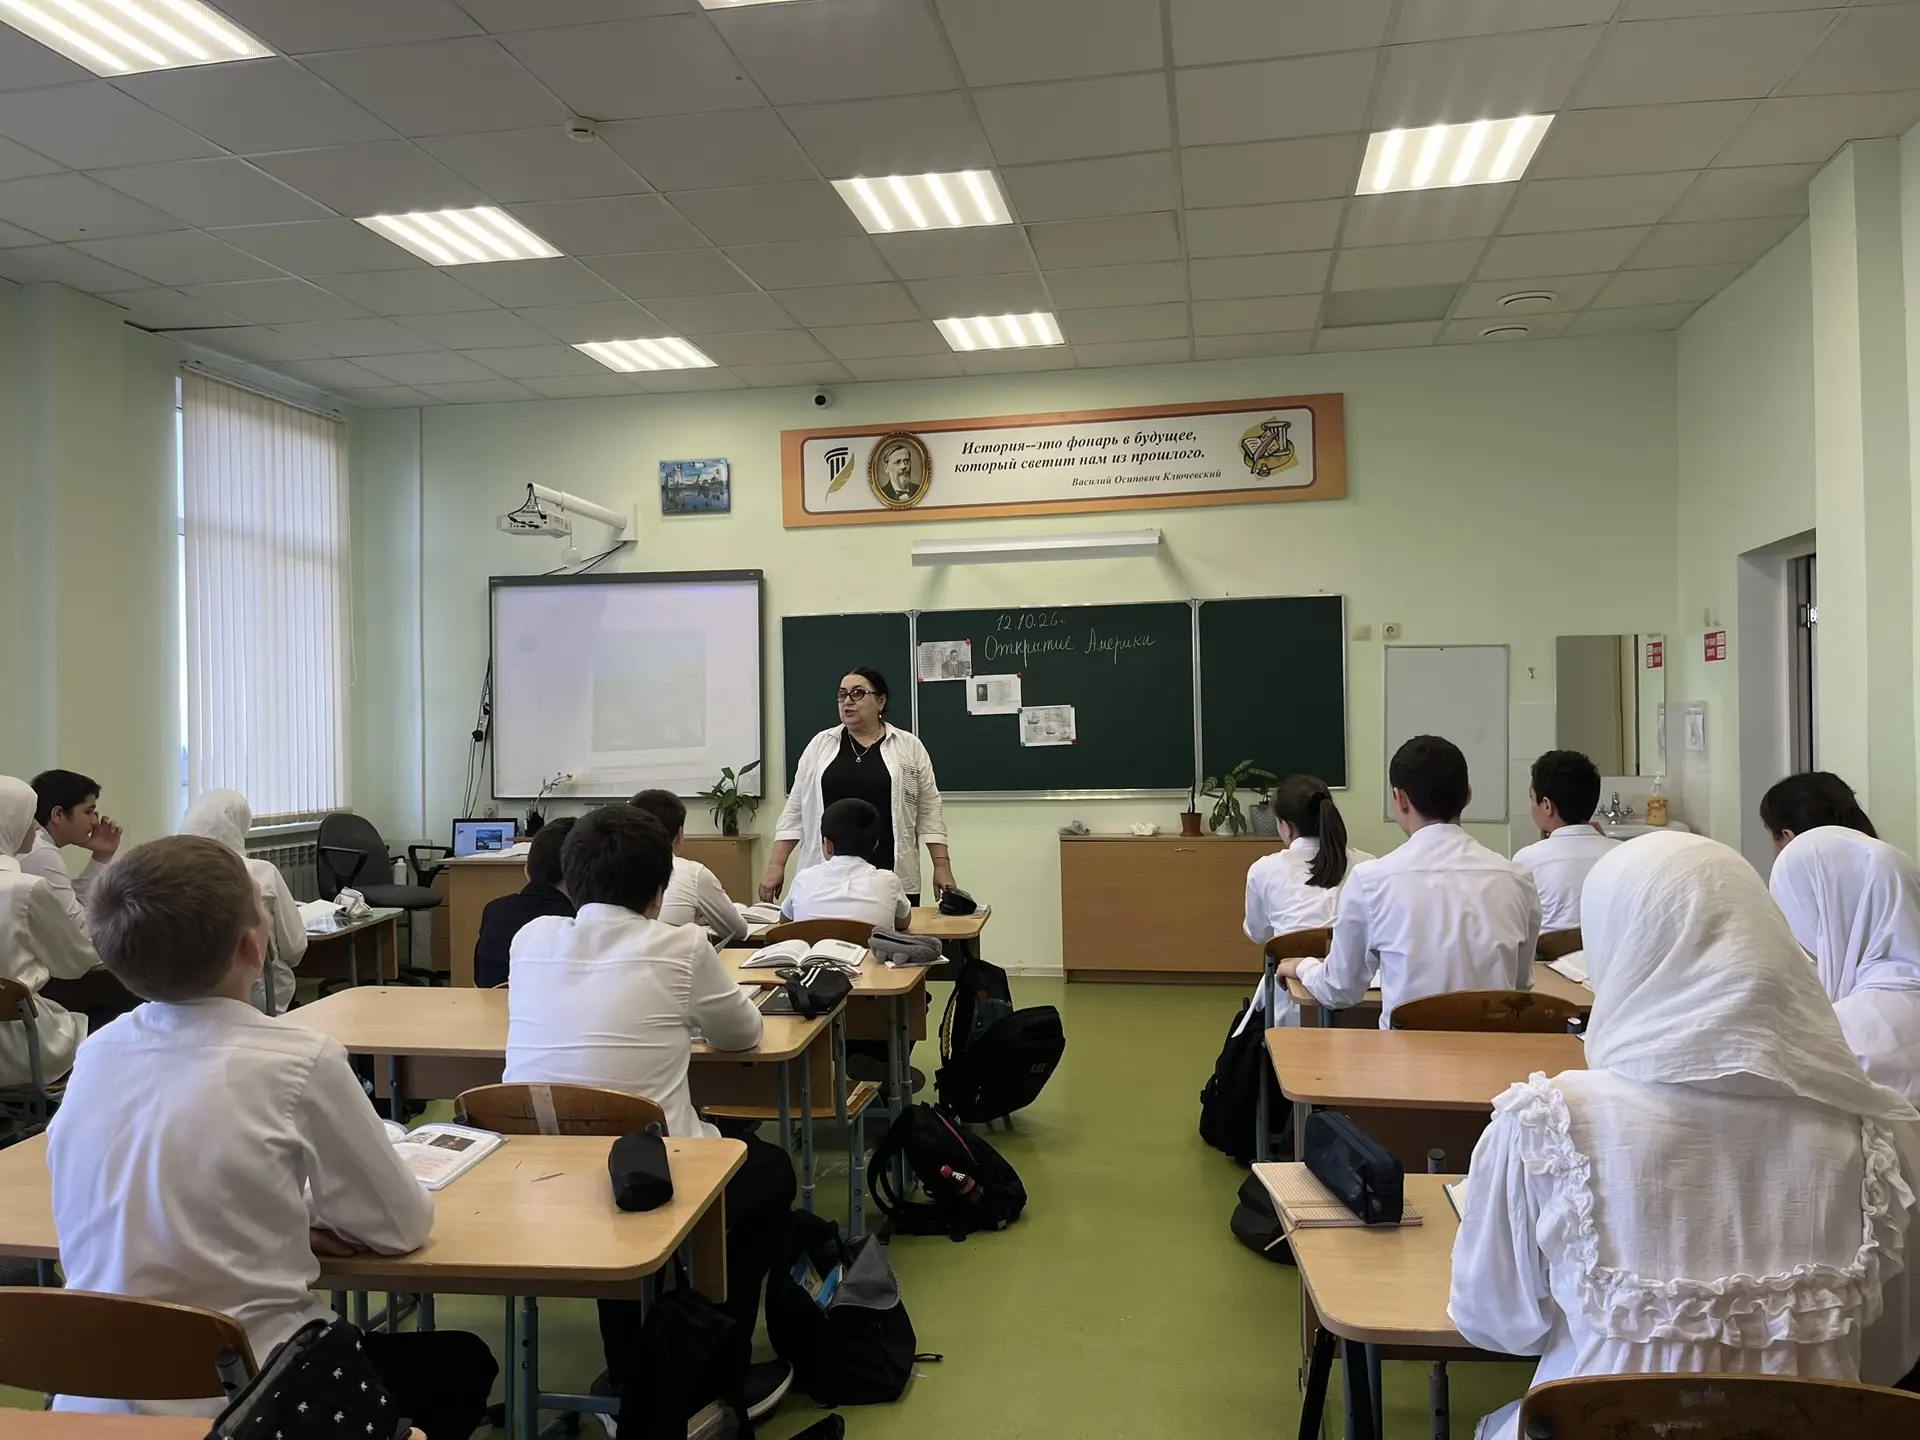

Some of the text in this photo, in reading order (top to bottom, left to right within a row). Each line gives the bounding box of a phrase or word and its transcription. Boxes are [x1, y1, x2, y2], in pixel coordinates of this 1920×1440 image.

[1066, 436, 1119, 451] фонарь
[1123, 436, 1130, 445] в
[1134, 431, 1197, 447] будущее,
[954, 448, 1205, 475] который светит нам из прошлого.
[1072, 469, 1222, 487] Василий Осипович Ключевский
[984, 627, 1156, 668] Открытие Америки
